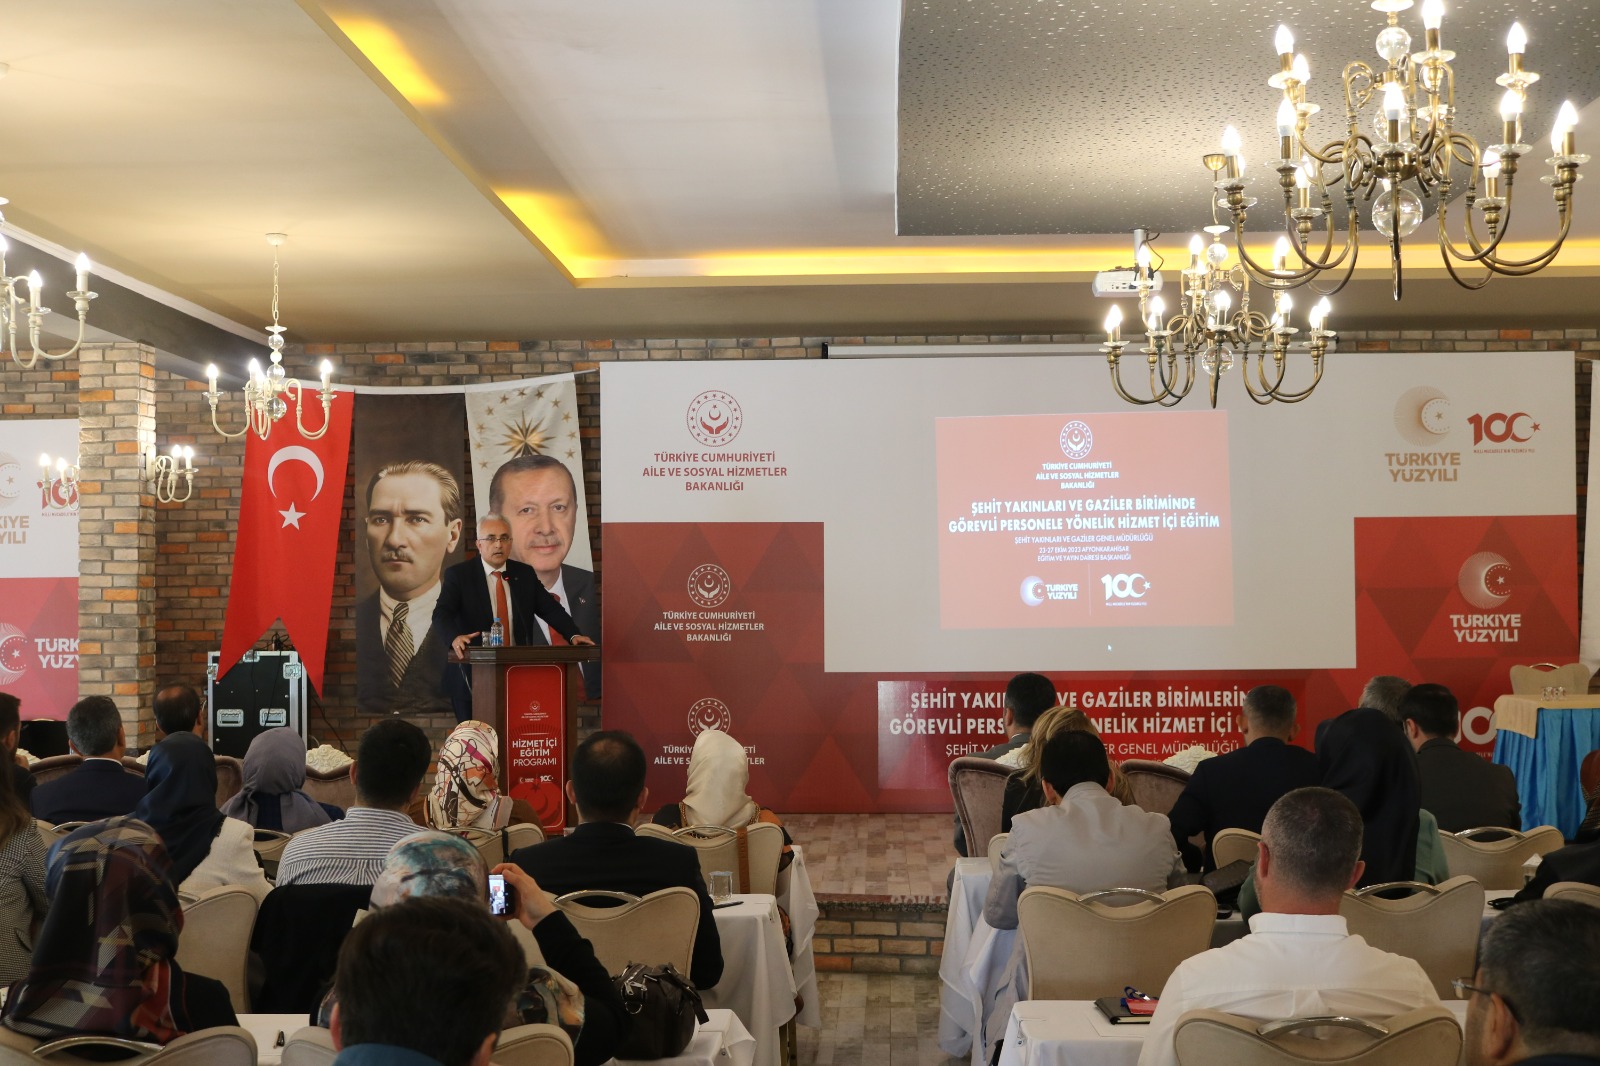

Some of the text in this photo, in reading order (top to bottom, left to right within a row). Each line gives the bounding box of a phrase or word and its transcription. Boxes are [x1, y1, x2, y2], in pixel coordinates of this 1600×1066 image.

[654, 451, 775, 463] TÜRKİYE CUMHURİYETİ
[1384, 452, 1461, 467] TÜRKİYE
[642, 465, 787, 477] AİLE VE SOSYAL HİZMETLER
[1042, 461, 1112, 470] TÜRKİYE CUMHURİYETİ
[1036, 472, 1050, 480] AİLE
[1059, 472, 1083, 480] SOSYAL
[1084, 471, 1119, 479] HİZMETLER
[1389, 468, 1458, 482] YÜZYILI
[685, 480, 744, 491] BAKANLIĞI
[1060, 480, 1095, 489] BAKANLIĞI
[971, 494, 1196, 517] ŞEHİT YAKINLARI VE GAZİLER BİRİMİNDE
[948, 512, 1220, 533] GÖREVLİ PERSONELE YÖNELİK HİZMET İÇİ EĞİTİM
[0, 531, 26, 544] YILI
[1014, 532, 1154, 545] ŞEHİT YAKINLARI VE GAZİLER GENEL MÜDÜRLÜĞÜ
[1054, 545, 1067, 553] EKİM
[1081, 545, 1130, 553] AFYONKARAHİSAR
[1037, 554, 1055, 562] EĞİTİM
[1062, 554, 1079, 562] YAYIN
[1080, 553, 1099, 561] DAİRESİ
[1099, 553, 1131, 562] BAŞKANLIĞI
[662, 610, 756, 620] TÜRKİYE CUMHURİYETİ
[1449, 614, 1522, 628] TÜRKİYE
[654, 622, 765, 631] AİLE VE SOSYAL HİZMETLER
[686, 633, 732, 642] BAKANLIĞI
[1453, 629, 1519, 643] YÜZYILI
[34, 638, 79, 652] TÜRK
[911, 687, 956, 713] ŞEHİT
[1056, 692, 1077, 708] VE
[1082, 685, 1152, 708] GAZİLER
[889, 713, 961, 735] GÖREVLİ
[1091, 712, 1138, 734] NELİK
[1143, 711, 1205, 734] HİZMET
[1210, 711, 1232, 737] İÇİ
[512, 737, 557, 749] HİZMET İÇİ
[662, 744, 694, 754] TÜRKİY
[945, 741, 978, 757] ŞEHİT
[1118, 743, 1158, 755] GENEL
[520, 747, 550, 757] EĞİTİM
[513, 757, 557, 767] PROGRAMI
[654, 756, 672, 765] AİLE
[673, 757, 684, 765] VE
